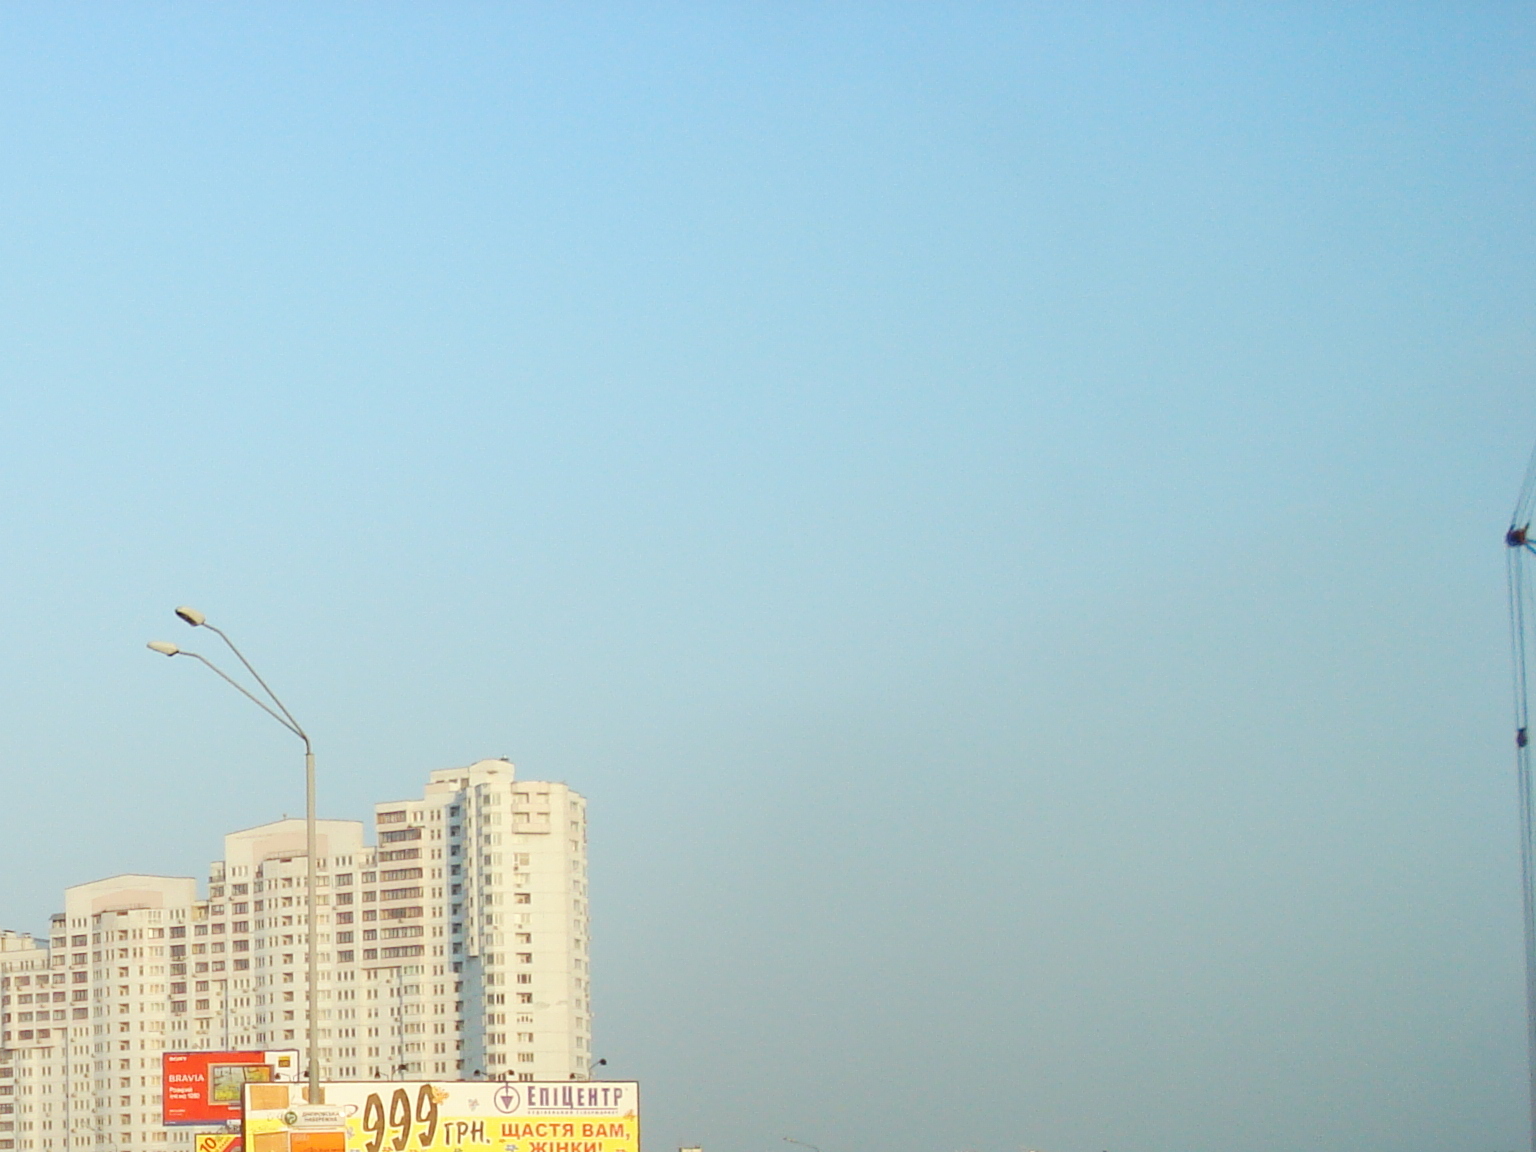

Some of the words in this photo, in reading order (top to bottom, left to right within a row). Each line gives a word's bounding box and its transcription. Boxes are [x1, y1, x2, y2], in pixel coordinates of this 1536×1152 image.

[168, 1074, 205, 1082] BRAVIA
[443, 1120, 491, 1146] ГРН.
[501, 1123, 575, 1140] ЩАСТЯ
[582, 1123, 631, 1140] ВАМ,
